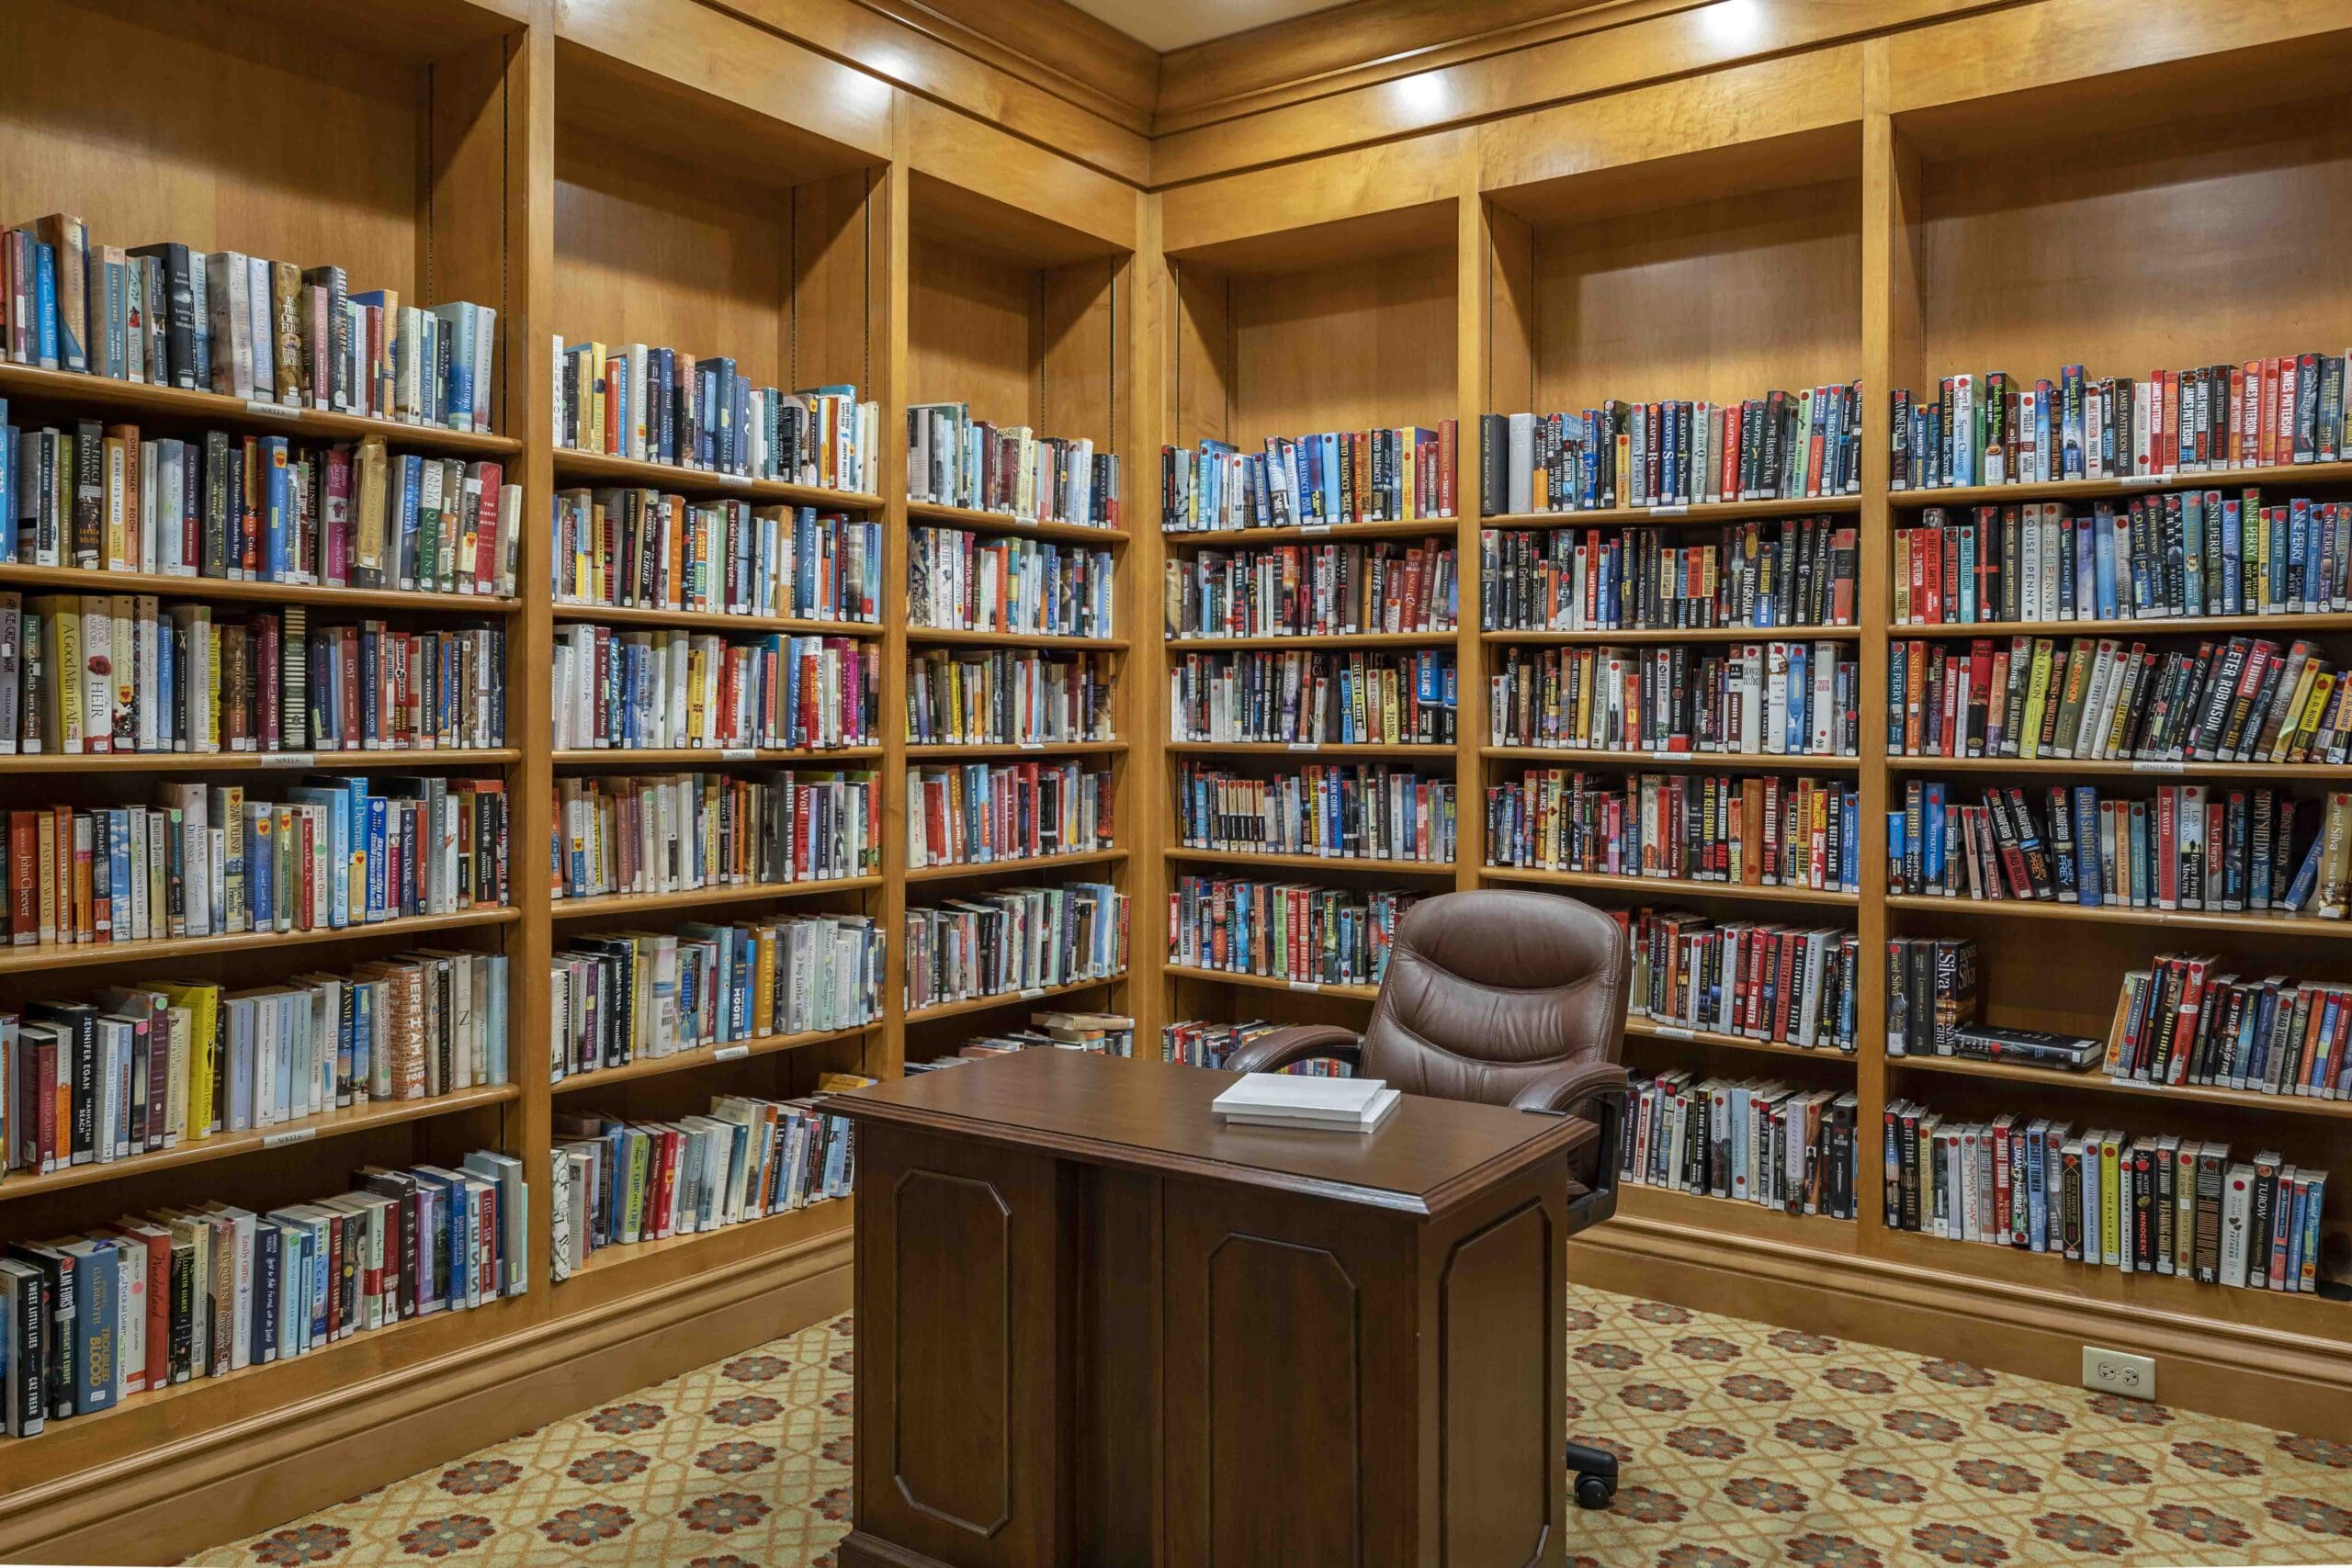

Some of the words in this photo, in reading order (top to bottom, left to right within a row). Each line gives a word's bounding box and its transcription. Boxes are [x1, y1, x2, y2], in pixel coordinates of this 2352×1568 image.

[2152, 382, 2161, 401] JAMES
[2184, 387, 2194, 410] JAMES
[2247, 375, 2258, 398] JAMES
[1959, 420, 1967, 441] Spare
[2152, 402, 2161, 434] PATTERSON
[2182, 411, 2193, 446] PATTERSON
[2245, 399, 2257, 434] PATTERSON
[2281, 394, 2293, 436] PATTERSON
[83, 434, 91, 486] RADIANCE
[92, 449, 100, 487] FIERCE
[1956, 444, 1964, 473] Change
[426, 463, 435, 507] BINCHY
[434, 468, 442, 507] MAEVE
[645, 508, 653, 542] HOSSEINI
[2247, 522, 2257, 556] PERRY
[424, 511, 437, 576] QUENTINS
[2211, 531, 2220, 558] PERRY
[2292, 534, 2303, 561] PERRY
[1519, 567, 1527, 599] Grimes
[2024, 567, 2035, 604] PENNY
[1235, 600, 1243, 631] TSAR
[346, 660, 355, 679] LOST
[2032, 664, 2045, 698] RANKIN
[2067, 669, 2082, 704] RANKIN
[92, 682, 103, 718] HEIR
[1892, 679, 1902, 703] PERRY
[2207, 681, 2233, 731] ROBINSON
[799, 789, 808, 814] Wolf
[2163, 797, 2171, 835] BETRAYED
[1703, 799, 1714, 840] KELLERMAN
[1994, 805, 2011, 839] SANDFORD
[2055, 807, 2069, 840] SANDFORD
[187, 822, 196, 865] DELINSKY
[197, 823, 206, 862] BARBARA
[1716, 843, 1727, 867] RAGE
[2330, 828, 2342, 851] Silva
[2058, 854, 2067, 886] PREY
[22, 878, 31, 918] Cheever
[1892, 976, 1902, 996] Silva
[1938, 953, 1956, 990] Silva
[410, 973, 421, 1012] HERE
[732, 988, 741, 1028] MOORE
[1747, 997, 1757, 1024] HUNTER
[2227, 1011, 2239, 1035] TAYLOR
[83, 1016, 92, 1064] JENNIFER
[411, 1033, 423, 1055] AM
[2274, 1031, 2286, 1048] THOR
[82, 1066, 91, 1089] EGAN
[2258, 1181, 2268, 1220] TUROW
[28, 1281, 38, 1304] SWEET
[220, 1263, 229, 1300] QUEEN
[28, 1306, 37, 1332] LITTLE
[28, 1332, 37, 1349] LIES
[101, 1326, 109, 1382] TROUBLED
[62, 1359, 71, 1385] EUROPE
[90, 1337, 101, 1387] BLOOD
[29, 1376, 38, 1392] CAZ
